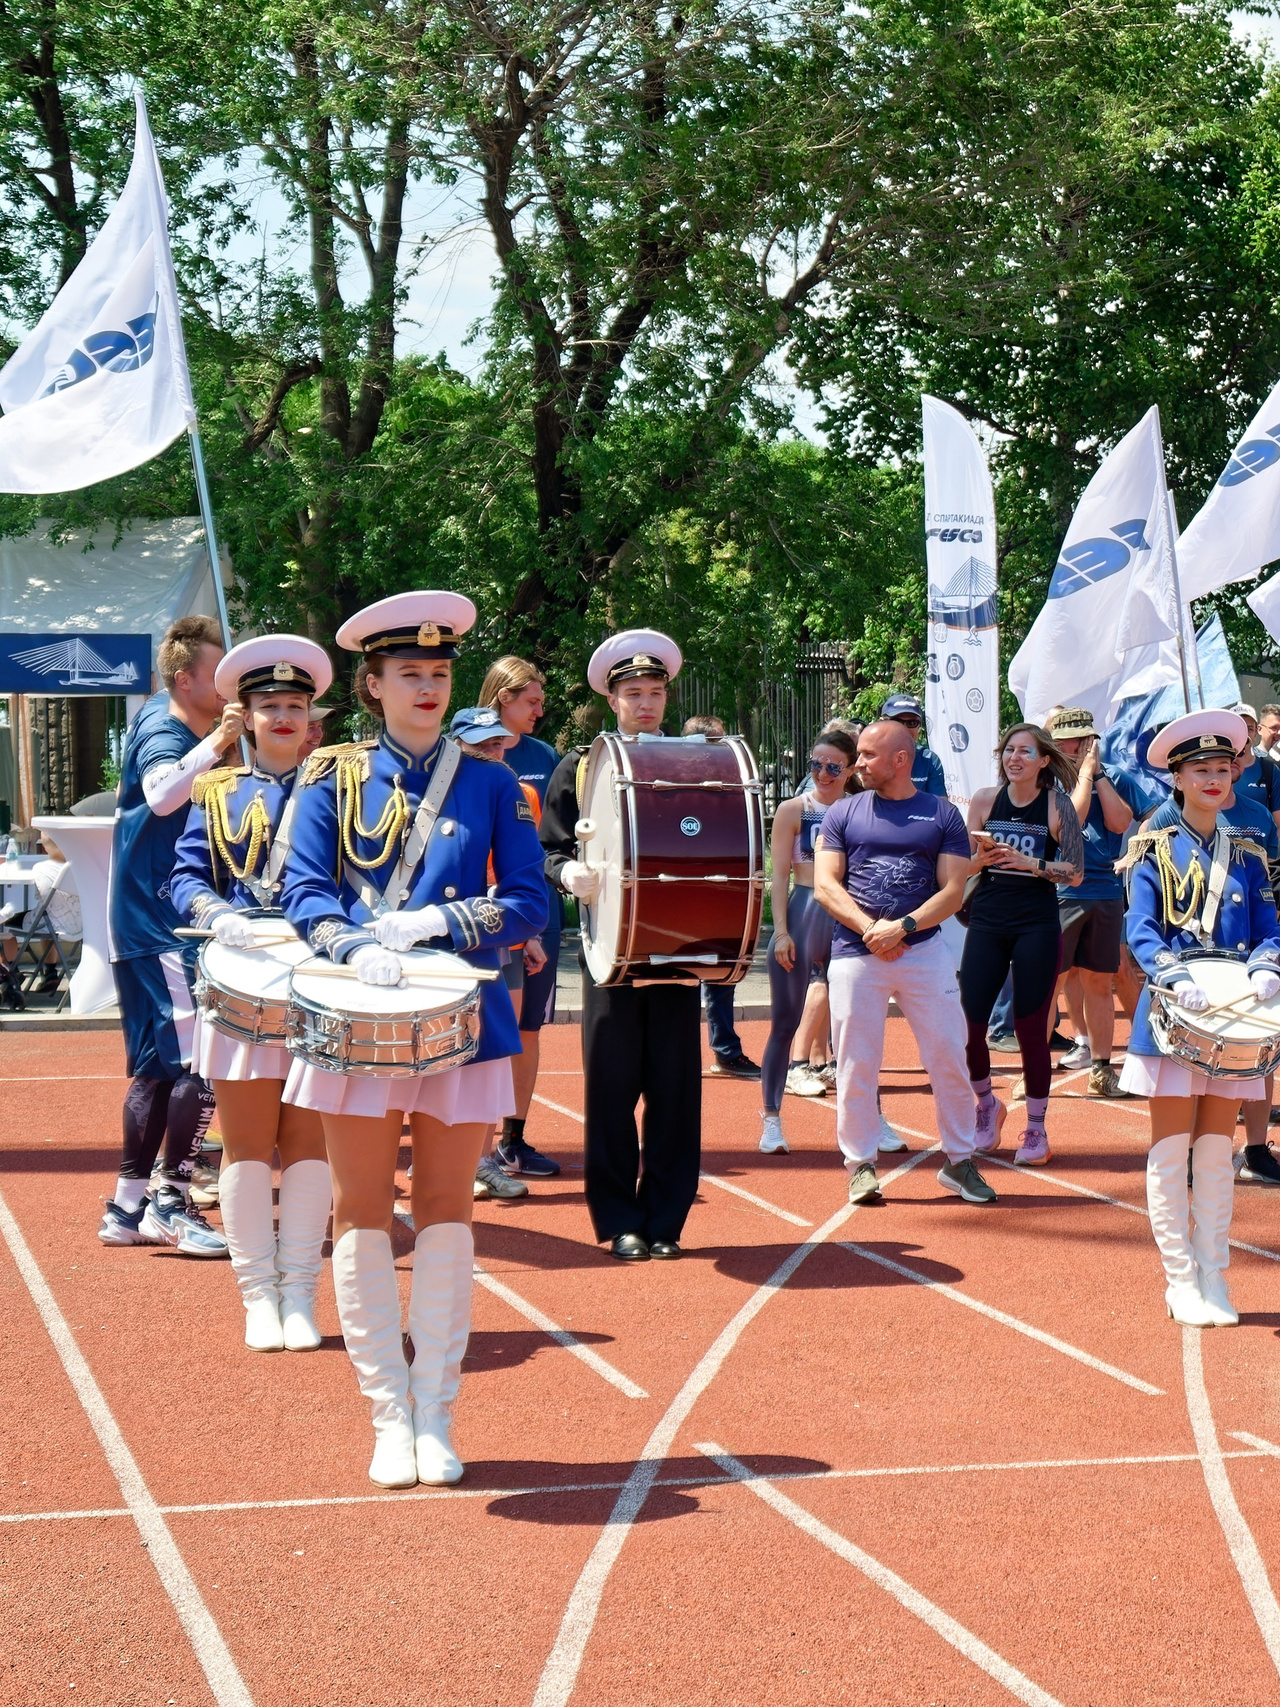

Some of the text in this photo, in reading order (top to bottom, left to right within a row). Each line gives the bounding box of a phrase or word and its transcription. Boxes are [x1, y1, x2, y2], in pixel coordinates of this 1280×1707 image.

[933, 513, 984, 525] СПАРТАКИАДА
[925, 528, 983, 543] FESCO
[188, 1106, 215, 1157] VENUM
